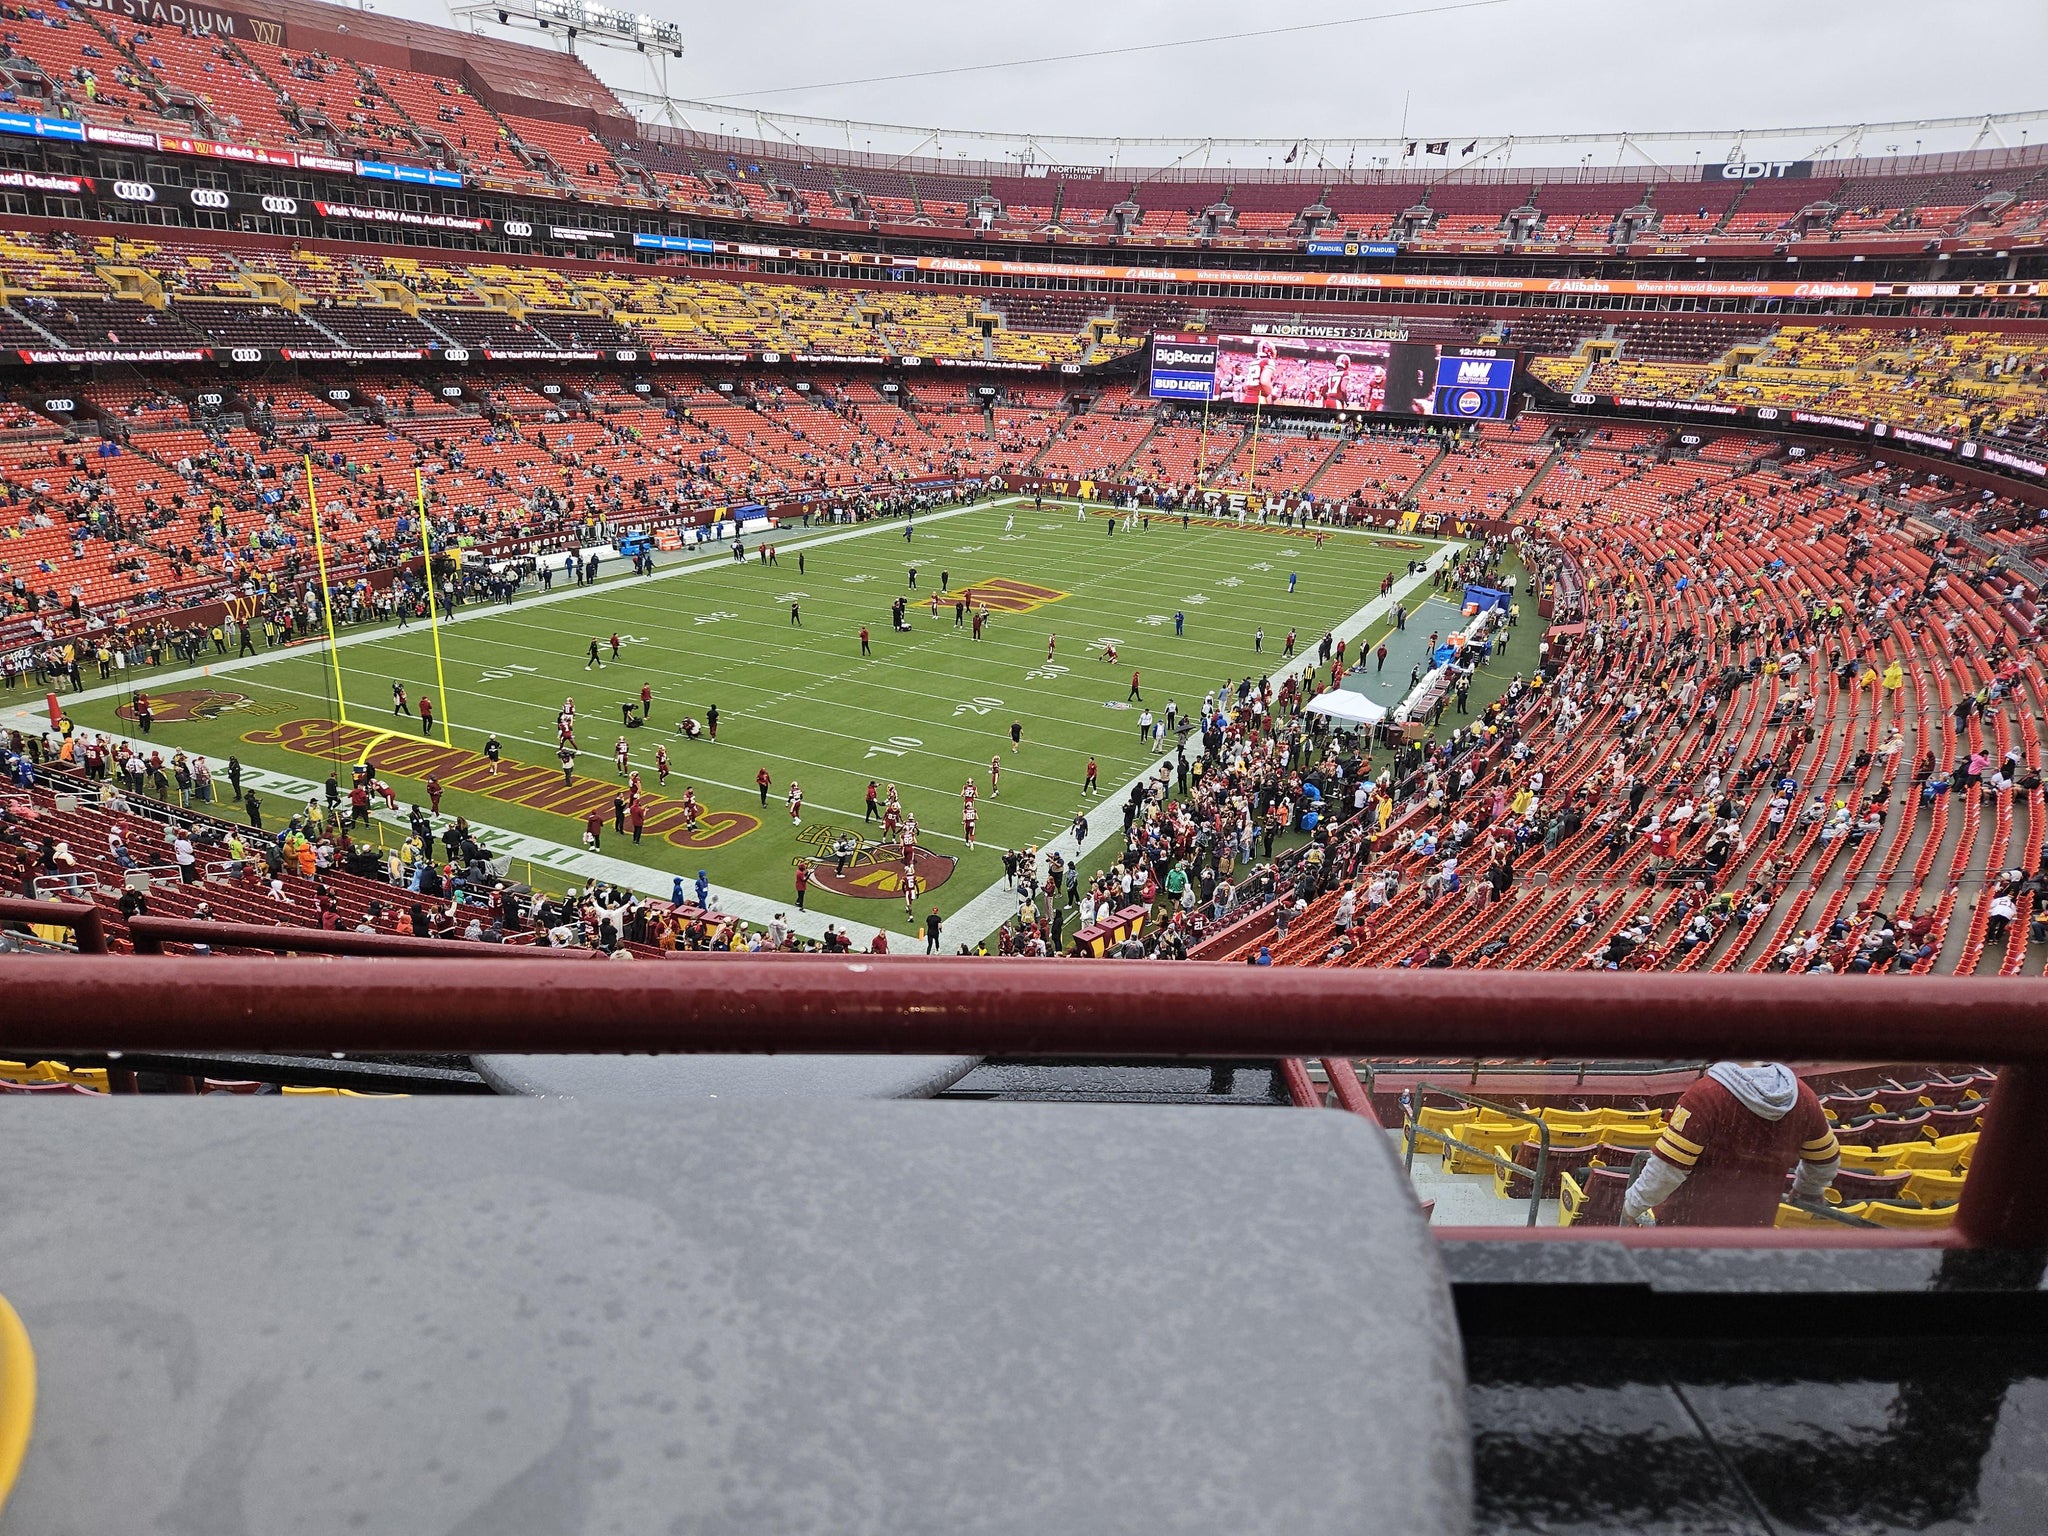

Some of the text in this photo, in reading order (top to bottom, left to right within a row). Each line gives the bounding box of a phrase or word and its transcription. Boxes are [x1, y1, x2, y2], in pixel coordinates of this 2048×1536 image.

[124, 0, 234, 34] STADIUM
[1024, 164, 1103, 178] NW NORTHWEST
[1722, 161, 1794, 179] GDIT
[0, 173, 81, 192] udi Dealers
[324, 204, 482, 231] Visit Your DMV Area Audi Dealers
[942, 261, 981, 271] Alibaba
[1002, 263, 1106, 275] Where the World Buys American
[1138, 270, 1176, 279] Alibaba
[1197, 271, 1218, 279] Where
[1232, 272, 1253, 280] World
[1254, 273, 1271, 282] Buys
[1339, 276, 1381, 285] Alibaba
[1404, 277, 1428, 285] Where
[1443, 278, 1465, 286] World
[1467, 279, 1485, 288] Buys
[1486, 280, 1523, 288] American
[1562, 282, 1610, 292] Alibaba
[1636, 283, 1769, 293] Where the World Buys American
[1812, 286, 1859, 295] Alibaba
[1251, 323, 1409, 341] NW NORTHWEST STADIUM
[30, 349, 202, 362] Visit Your DMV Area Audi Dealers
[290, 350, 422, 360] Visit Your DMV Area Audi Dealers
[490, 350, 598, 360] Visit Your DMV Area Audi Dealers
[655, 352, 747, 361] Visit Your DMV Area Audi Dealers
[796, 354, 883, 364] Visit Your DMV Area Audi Dealers
[1156, 348, 1214, 365] BigBear.ai
[941, 359, 956, 367] Visit
[956, 359, 970, 367] Your
[987, 360, 1002, 368] Area
[1003, 361, 1016, 369] Audi
[1018, 362, 1042, 370] Dealers
[1458, 361, 1493, 377] NW
[1154, 378, 1211, 391] BUD LIGHT
[1620, 397, 1737, 414] Visit Your DMV Area Audi Dealers
[619, 516, 697, 533] COMMANDERS
[482, 664, 539, 679] 10
[1026, 664, 1071, 680] 30
[955, 696, 1004, 715] 20
[869, 736, 924, 757] 10
[240, 719, 762, 850] COMMANDERS
[1783, 785, 1793, 793] 72
[529, 848, 583, 865] IT
[908, 879, 914, 888] 6
[1193, 920, 1203, 931] 21
